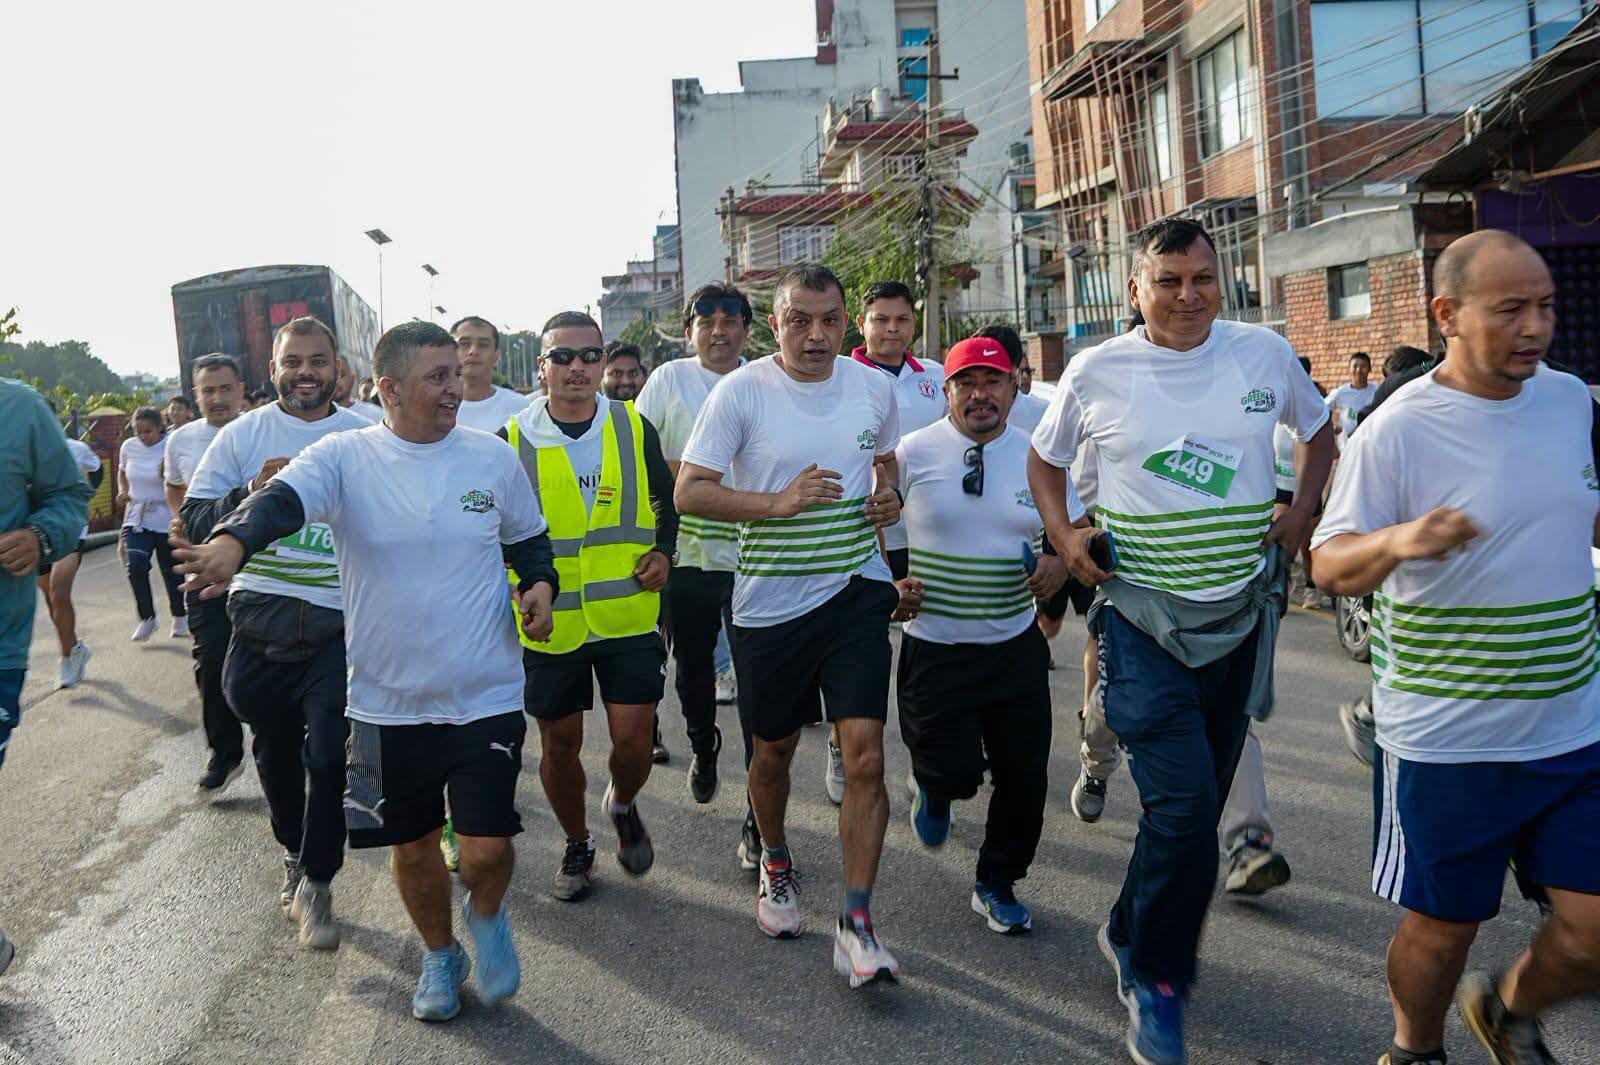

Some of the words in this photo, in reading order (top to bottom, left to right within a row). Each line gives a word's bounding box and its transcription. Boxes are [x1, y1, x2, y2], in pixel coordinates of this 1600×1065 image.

[1241, 391, 1266, 405] GREEN
[1162, 450, 1214, 484] 449
[460, 493, 485, 503] GREEN
[298, 526, 335, 549] 176
